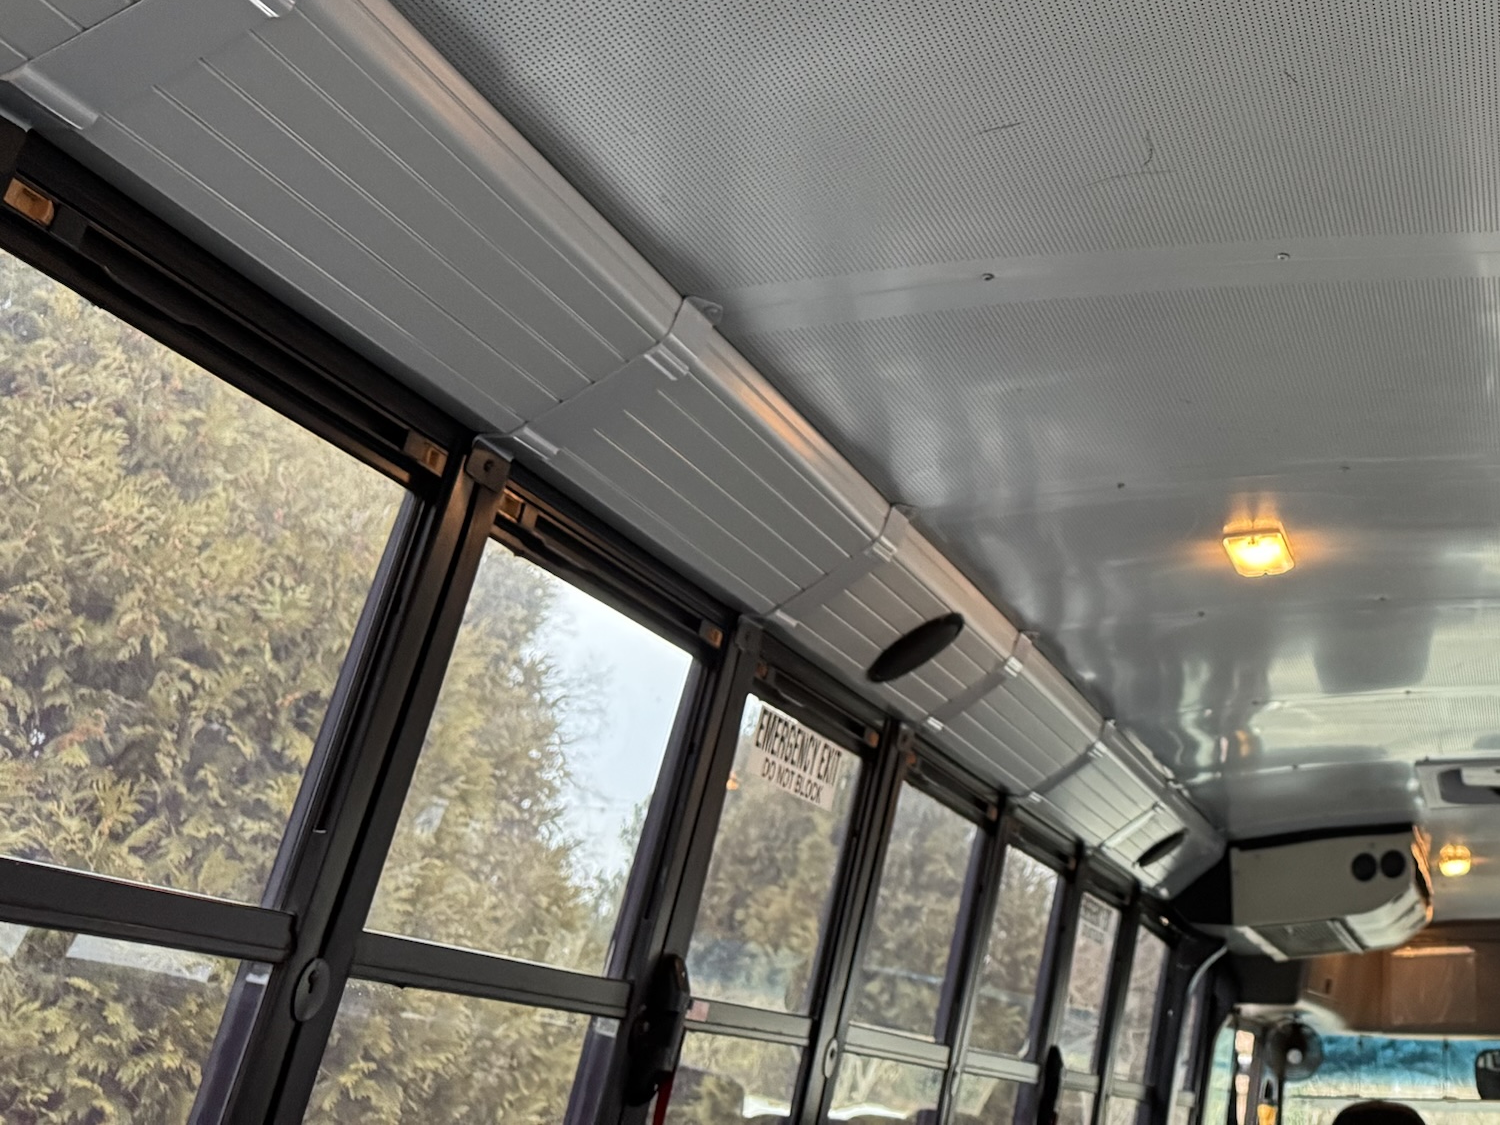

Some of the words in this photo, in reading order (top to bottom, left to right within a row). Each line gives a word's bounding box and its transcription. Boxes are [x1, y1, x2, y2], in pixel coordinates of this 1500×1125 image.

[755, 707, 822, 774] EMERGENCY
[816, 742, 843, 787] EXIT
[761, 757, 777, 782] DO
[776, 762, 796, 790] NOT
[794, 773, 825, 804] BLOCK
